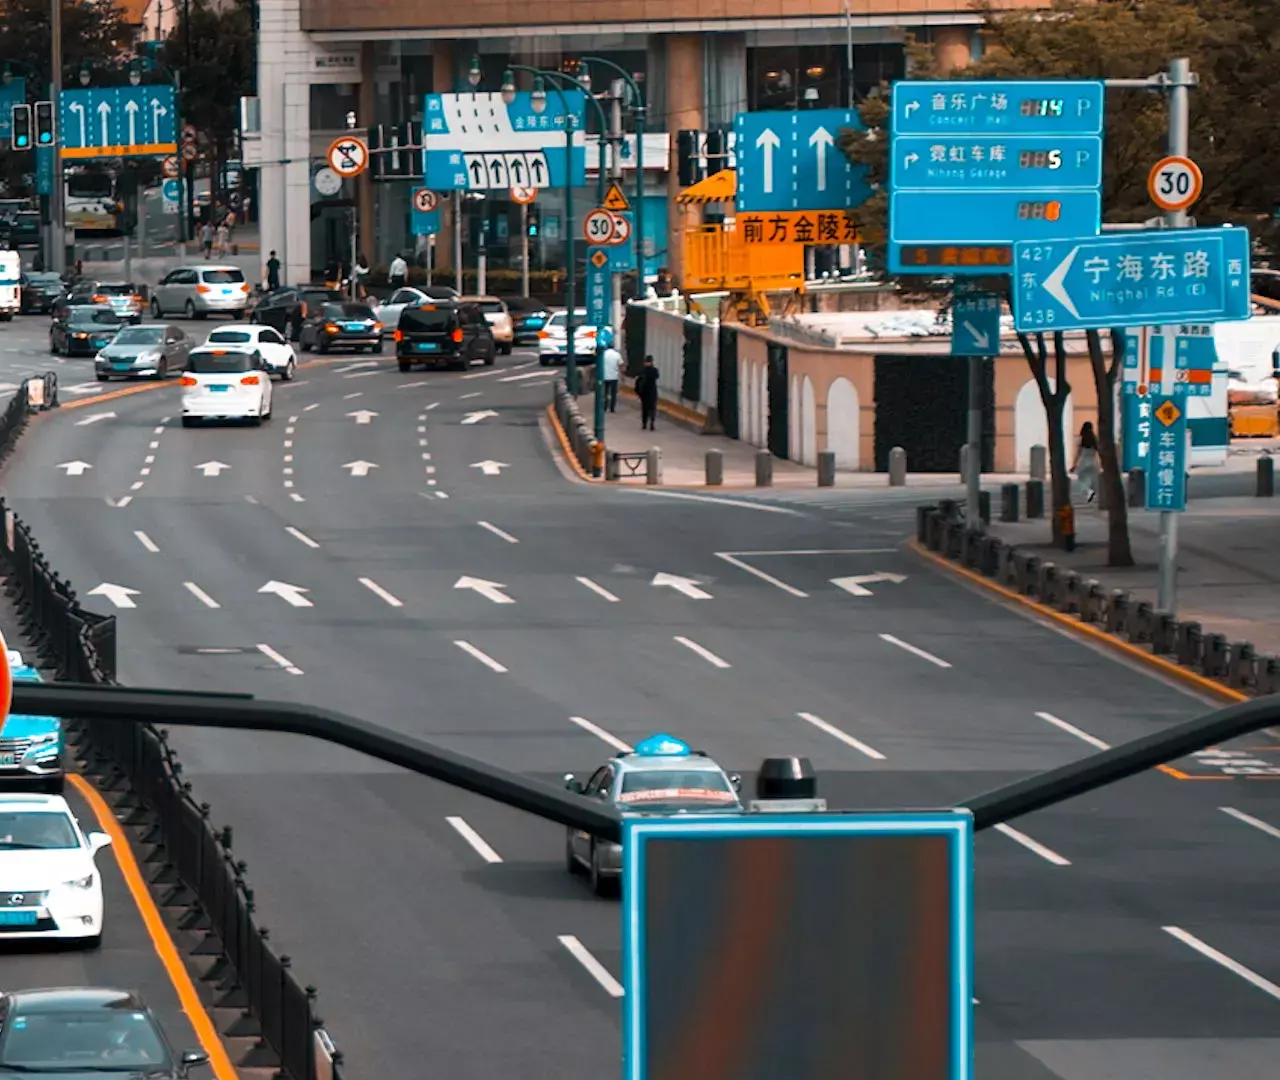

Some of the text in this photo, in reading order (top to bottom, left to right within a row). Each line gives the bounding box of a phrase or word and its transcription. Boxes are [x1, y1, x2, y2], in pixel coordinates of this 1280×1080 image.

[931, 93, 1008, 111] 音乐广场
[929, 145, 1007, 163] 霓虹车库
[1159, 172, 1190, 195] 30
[590, 218, 609, 236] 30
[1021, 247, 1053, 262] 427
[1083, 250, 1211, 284] 宁海东路
[1021, 272, 1038, 290] 东
[1090, 288, 1149, 305] Ninghai
[1022, 309, 1056, 325] 438
[1158, 431, 1177, 506] 车辆慢行
